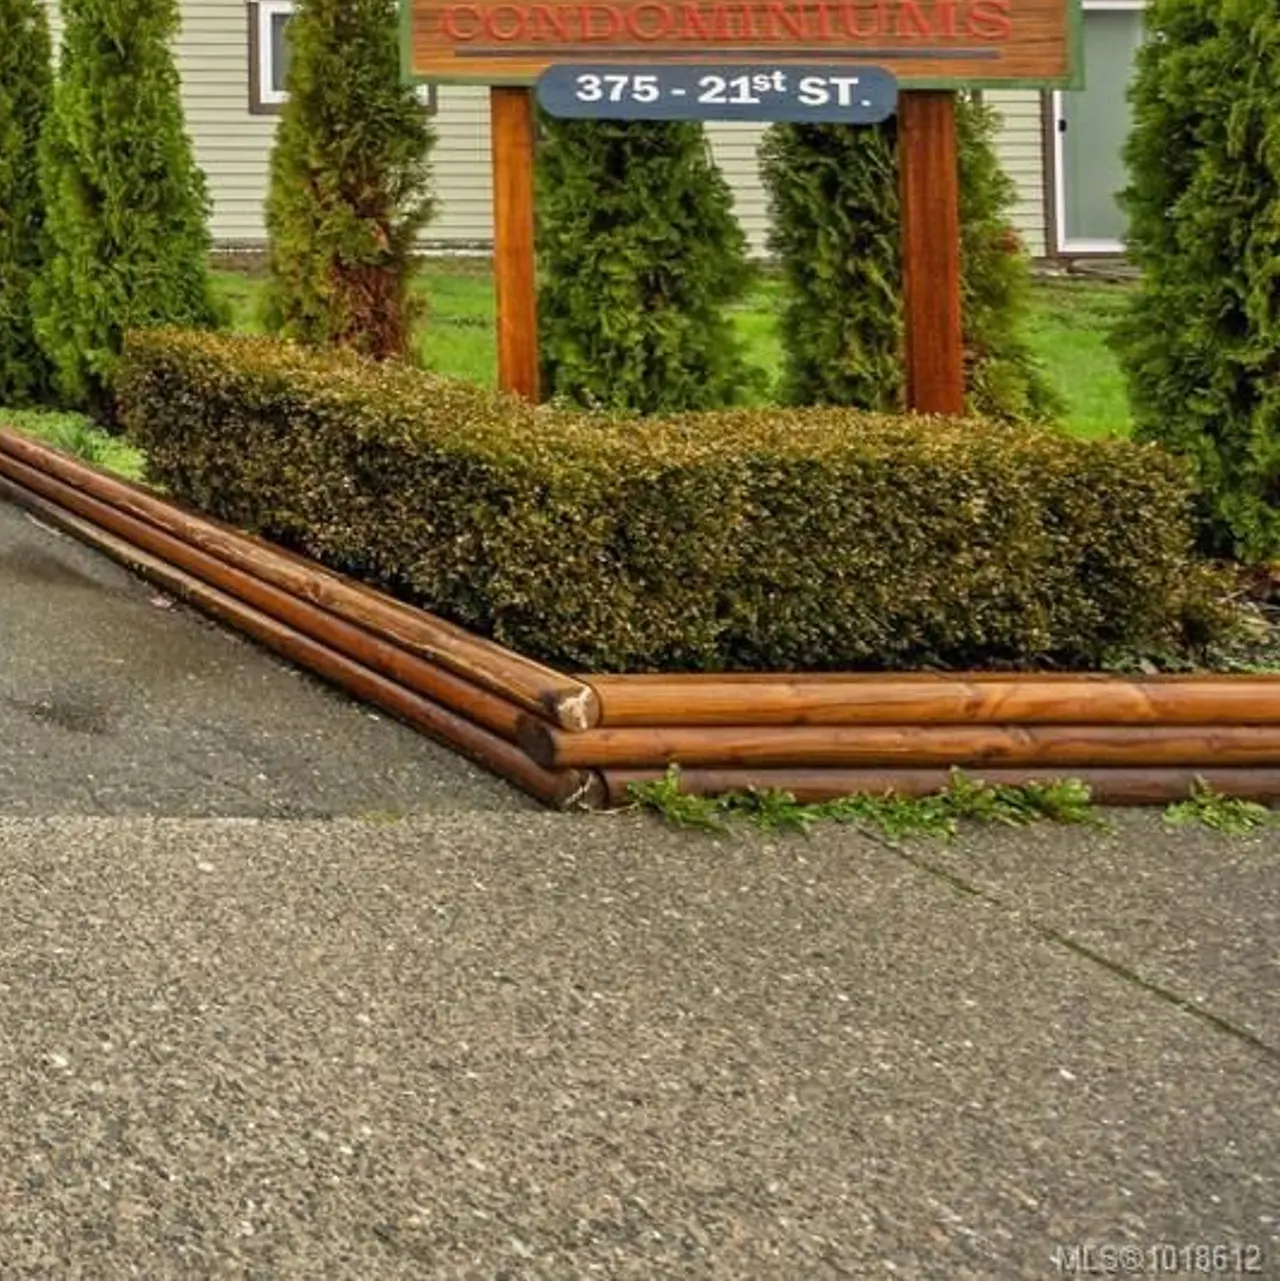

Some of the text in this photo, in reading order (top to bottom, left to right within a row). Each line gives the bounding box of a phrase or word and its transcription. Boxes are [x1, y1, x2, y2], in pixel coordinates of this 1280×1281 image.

[575, 73, 660, 103] 375
[697, 70, 787, 104] 21st
[797, 76, 871, 106] ST.
